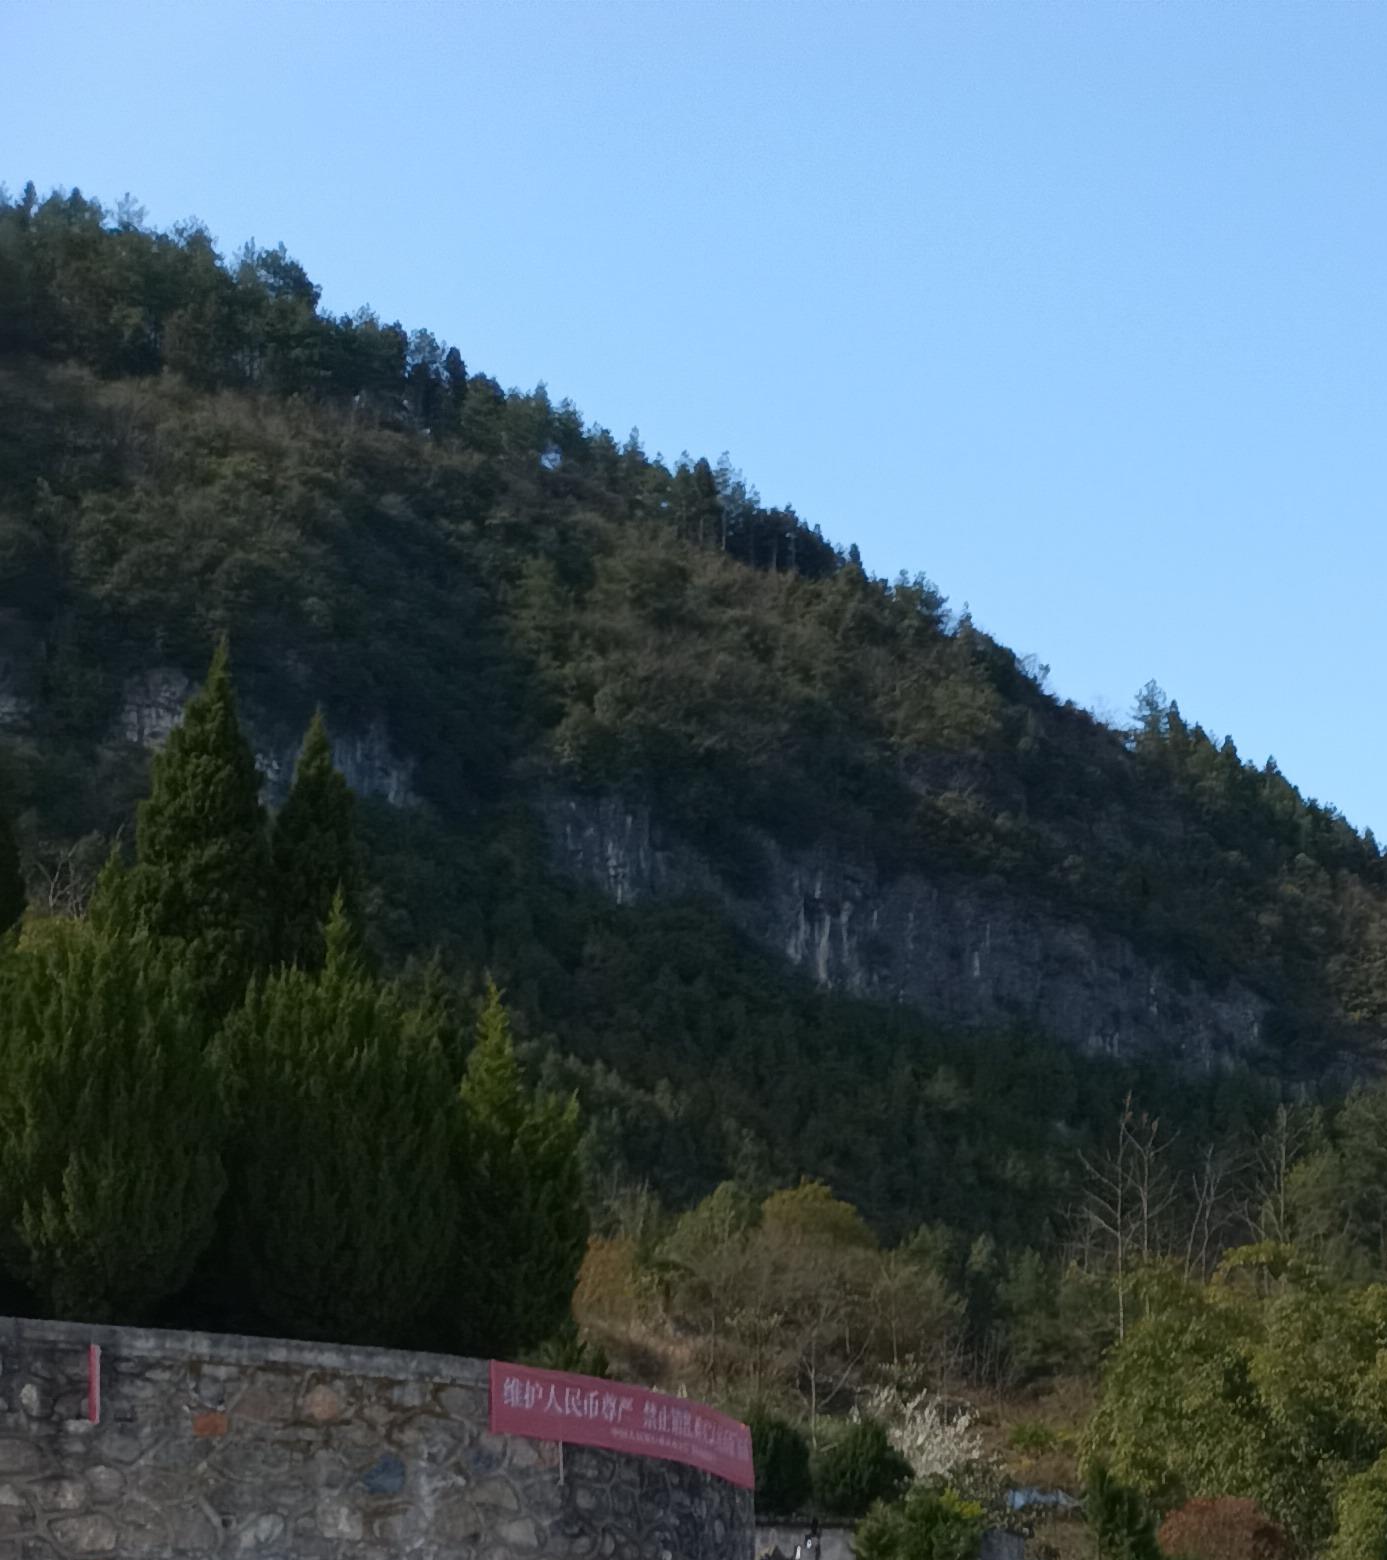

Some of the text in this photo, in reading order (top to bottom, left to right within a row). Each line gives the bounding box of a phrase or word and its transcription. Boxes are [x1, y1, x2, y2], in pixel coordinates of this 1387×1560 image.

[503, 1377, 634, 1424] 维护人民币尊严
